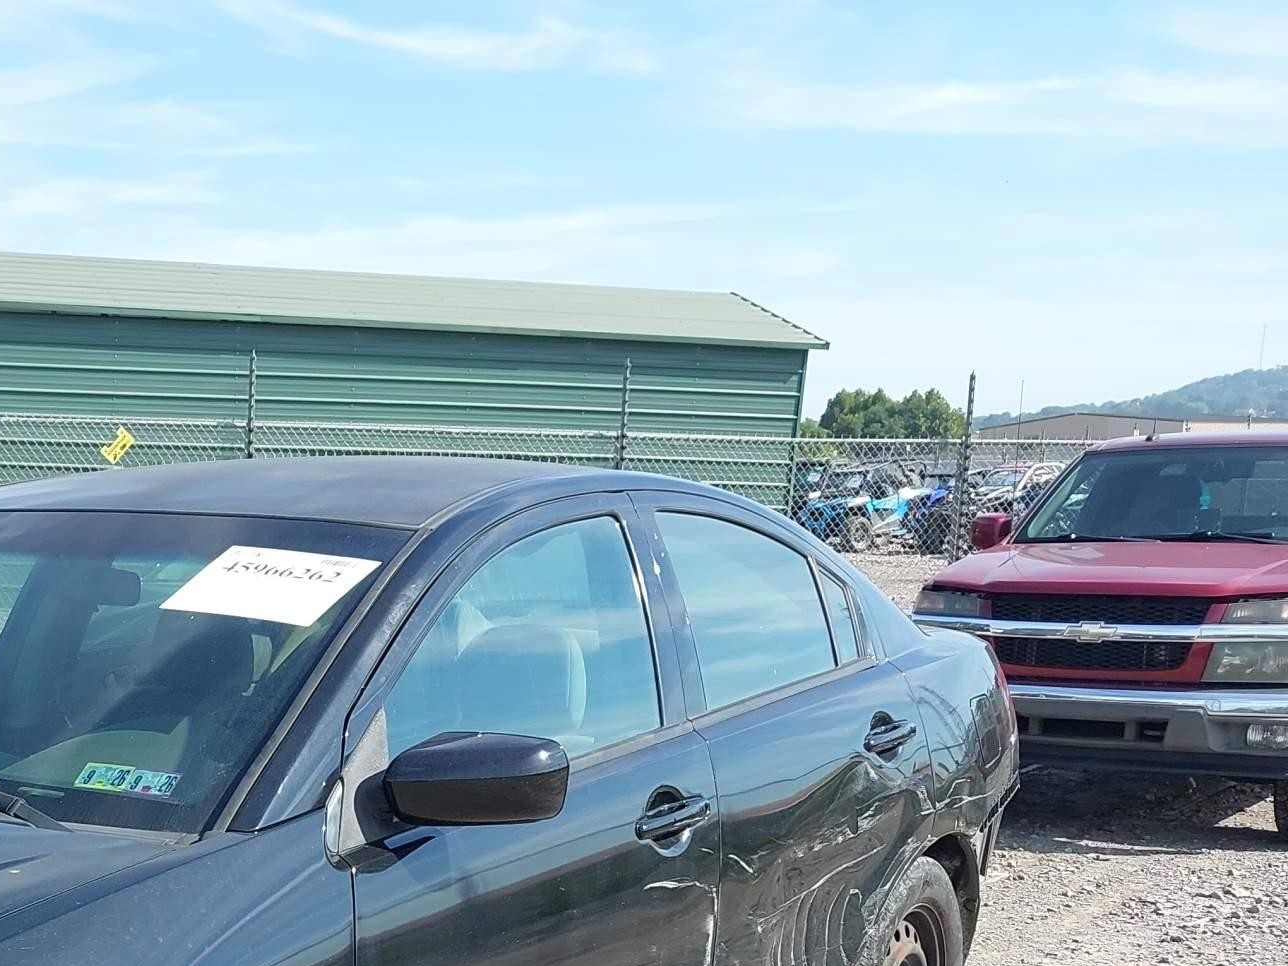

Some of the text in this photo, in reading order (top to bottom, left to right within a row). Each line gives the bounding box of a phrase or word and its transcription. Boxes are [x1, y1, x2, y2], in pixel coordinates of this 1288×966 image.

[221, 560, 343, 584] 45966262
[82, 769, 130, 787] 9 26
[129, 774, 178, 793] 9 26
